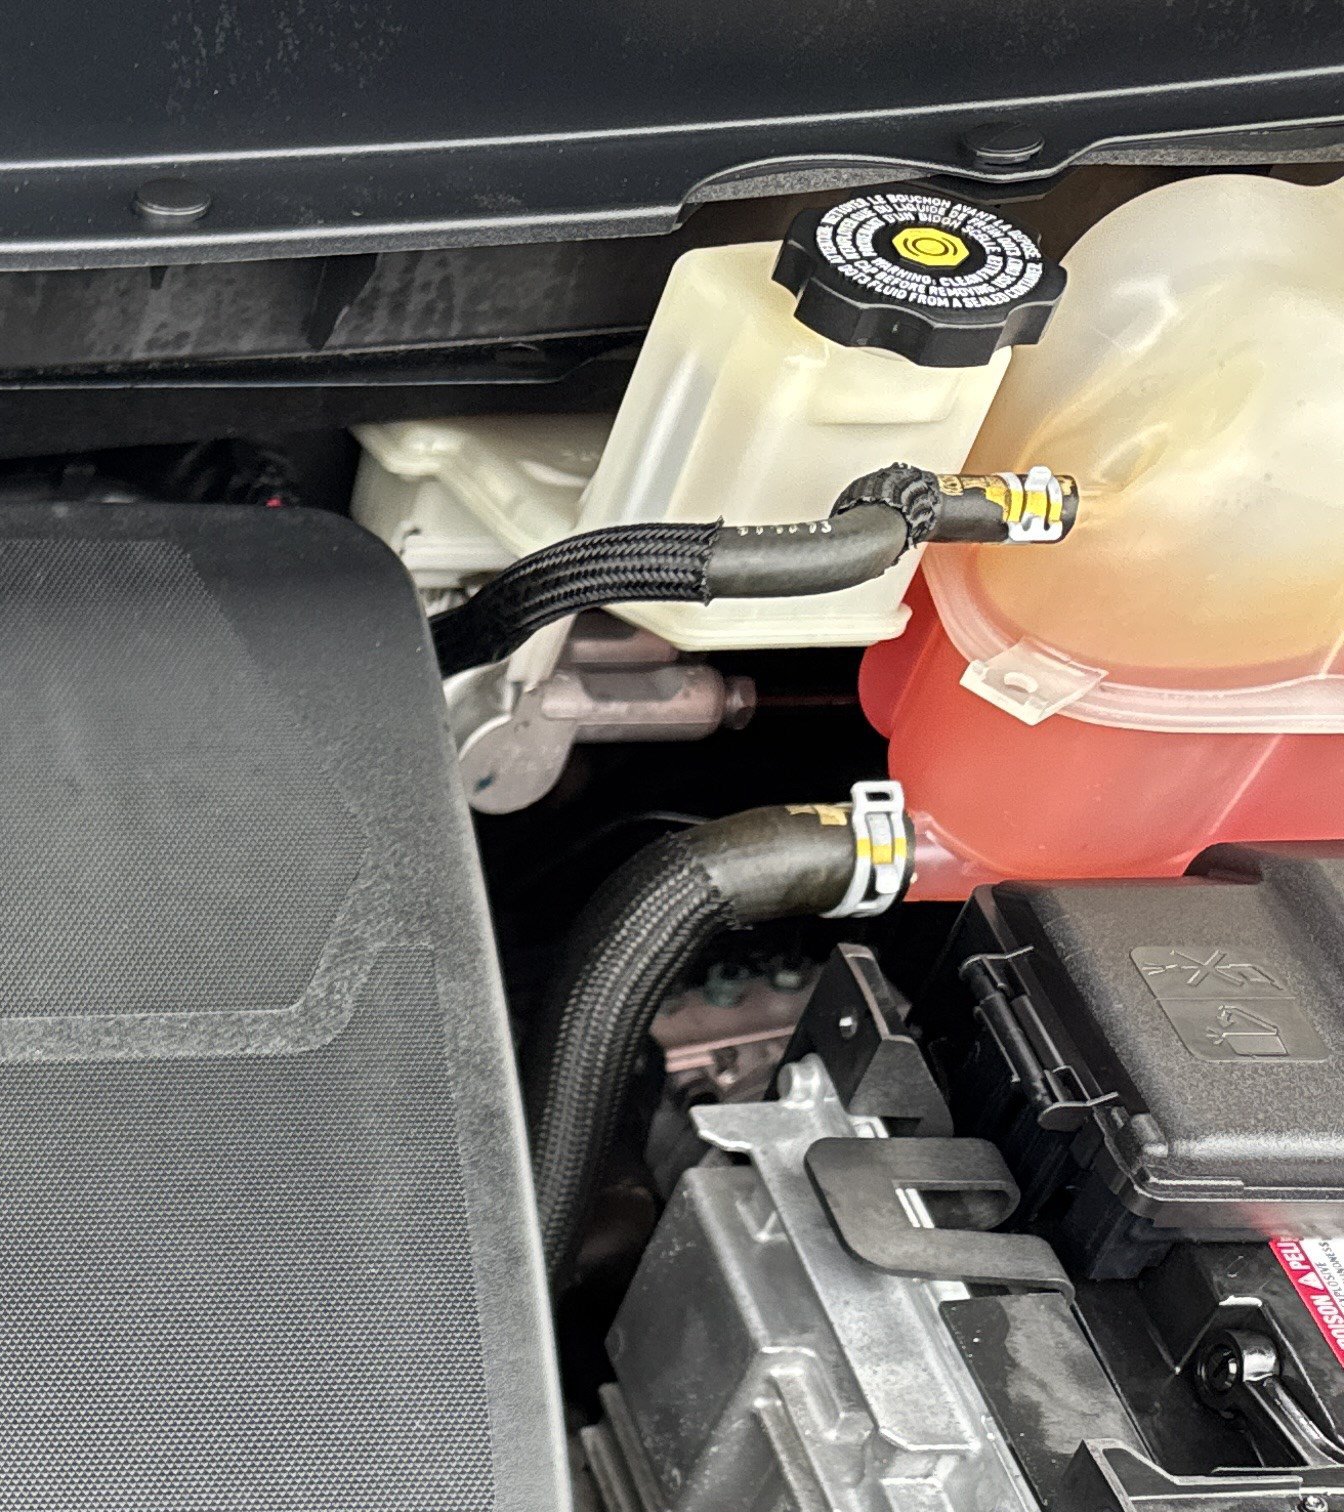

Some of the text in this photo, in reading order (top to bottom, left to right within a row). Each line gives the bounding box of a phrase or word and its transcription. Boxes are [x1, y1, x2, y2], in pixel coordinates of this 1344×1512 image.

[867, 194, 887, 205] LE
[886, 194, 951, 208] BOUCHON
[952, 203, 998, 221] AVANT
[992, 219, 1013, 232] LA
[872, 203, 894, 215] DU
[893, 203, 947, 216] LIQUIDE
[949, 209, 968, 221] DE
[918, 212, 962, 230] BIDON
[874, 271, 927, 294] BEFORE
[990, 272, 1017, 289] USE
[866, 280, 908, 300] FLUID
[908, 292, 950, 308] FROM
[952, 297, 963, 308] A
[962, 291, 1011, 309] SEALED
